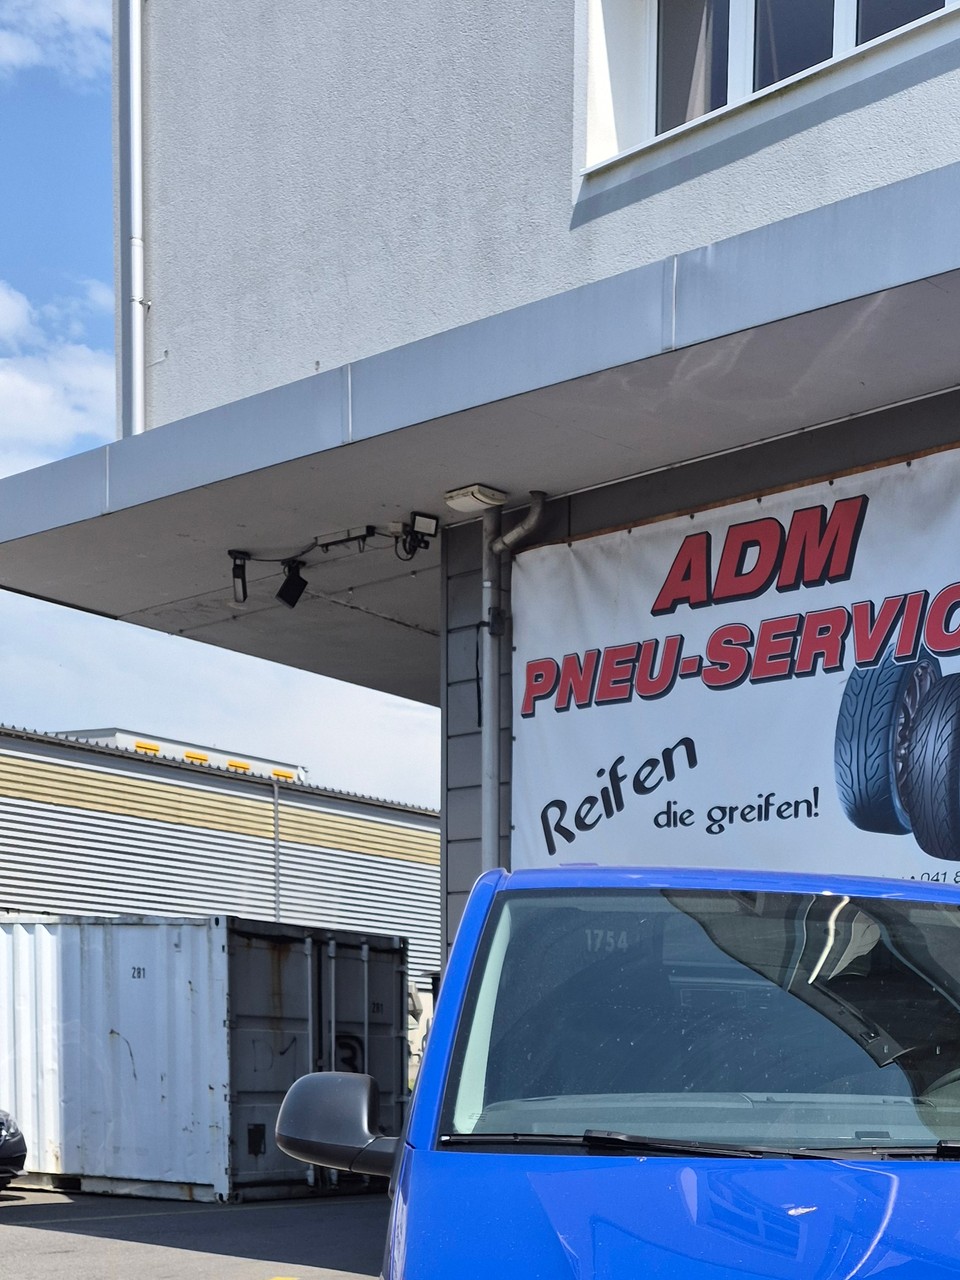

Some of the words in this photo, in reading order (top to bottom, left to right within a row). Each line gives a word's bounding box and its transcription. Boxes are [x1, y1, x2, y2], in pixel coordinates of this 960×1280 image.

[651, 494, 869, 616] ADM
[540, 736, 698, 856] Reifen
[653, 800, 695, 828] die
[705, 786, 820, 835] greifen!
[584, 928, 629, 953] 1754
